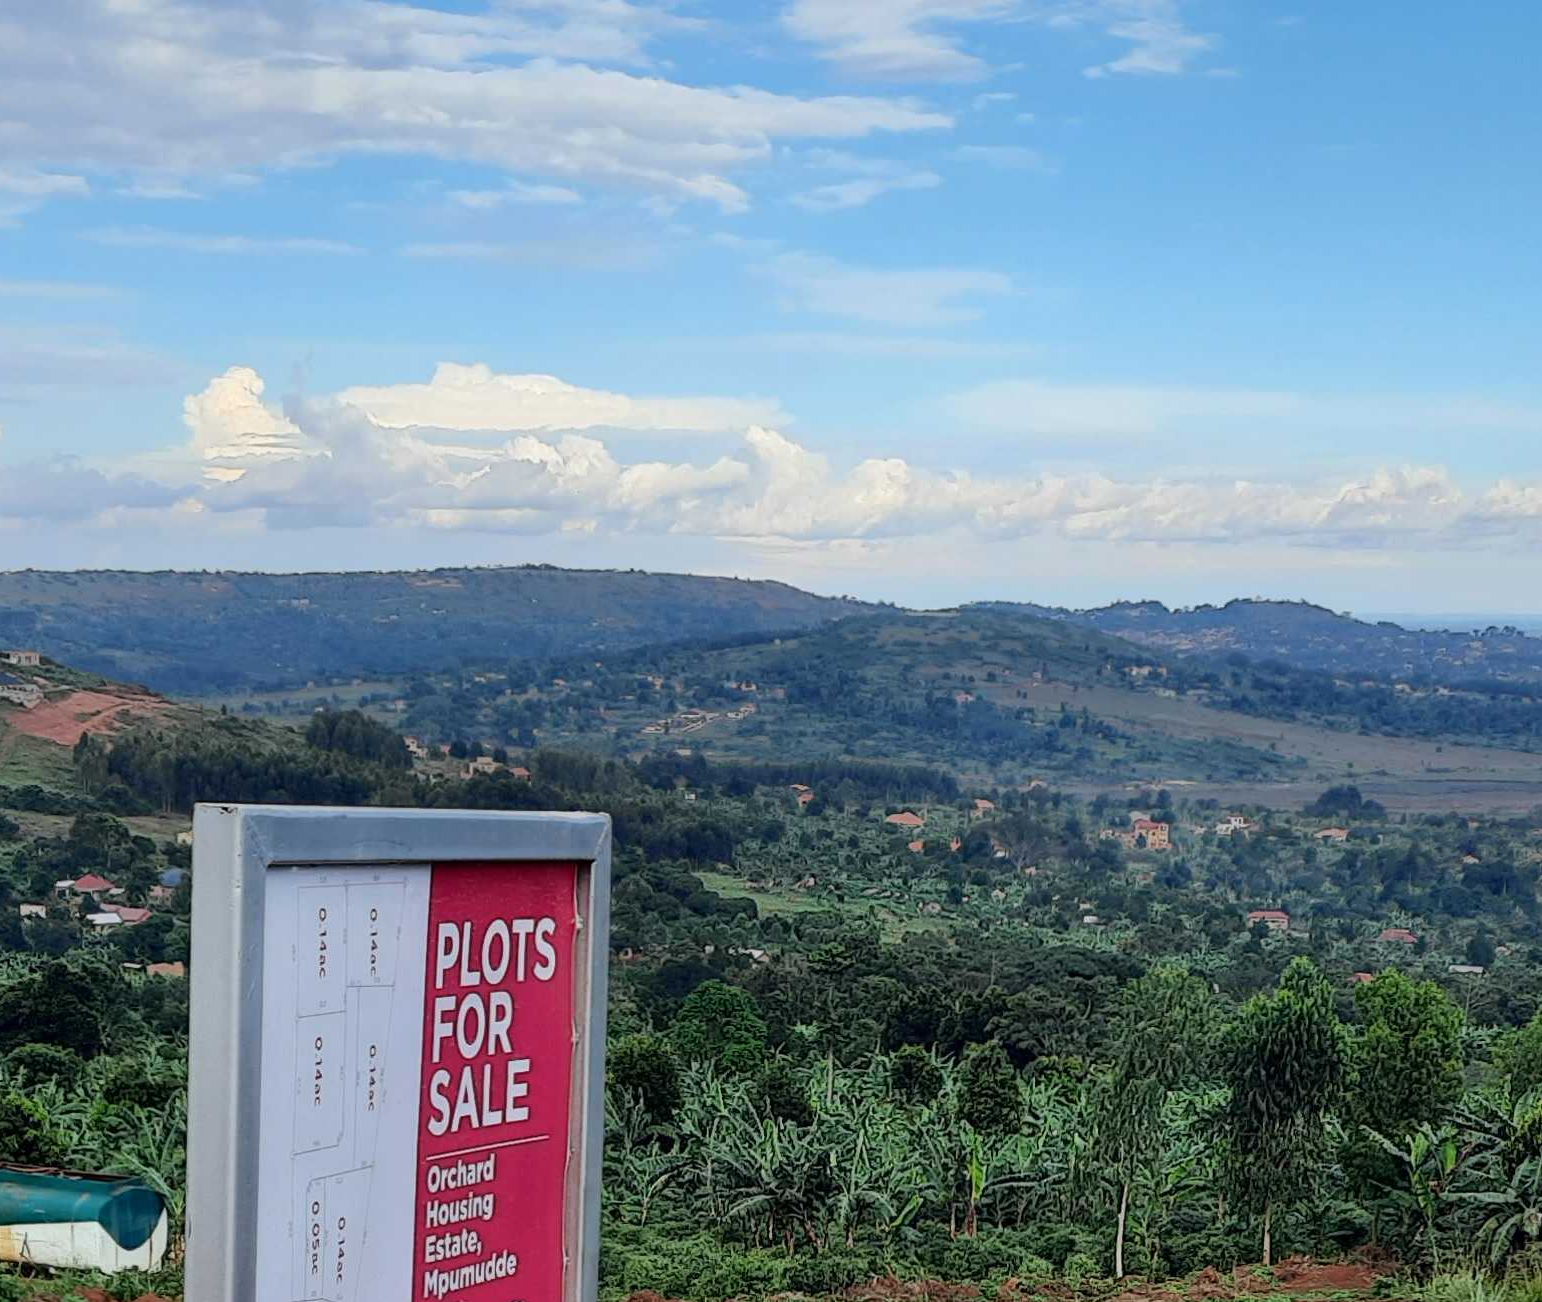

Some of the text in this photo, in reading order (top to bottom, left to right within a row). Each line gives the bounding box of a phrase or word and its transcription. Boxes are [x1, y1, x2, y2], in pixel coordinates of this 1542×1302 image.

[318, 907, 327, 979] 0.14ac
[369, 908, 378, 977] 0.14ac
[435, 917, 556, 989] PLOTS
[432, 991, 513, 1063] FOR
[427, 1058, 531, 1136] SALE
[427, 1153, 496, 1193] Orchard
[311, 1200, 320, 1275] 0.05ac
[425, 1192, 494, 1228] Housing
[423, 1250, 517, 1299] Mpumudde
[424, 1228, 482, 1263] Estate,
